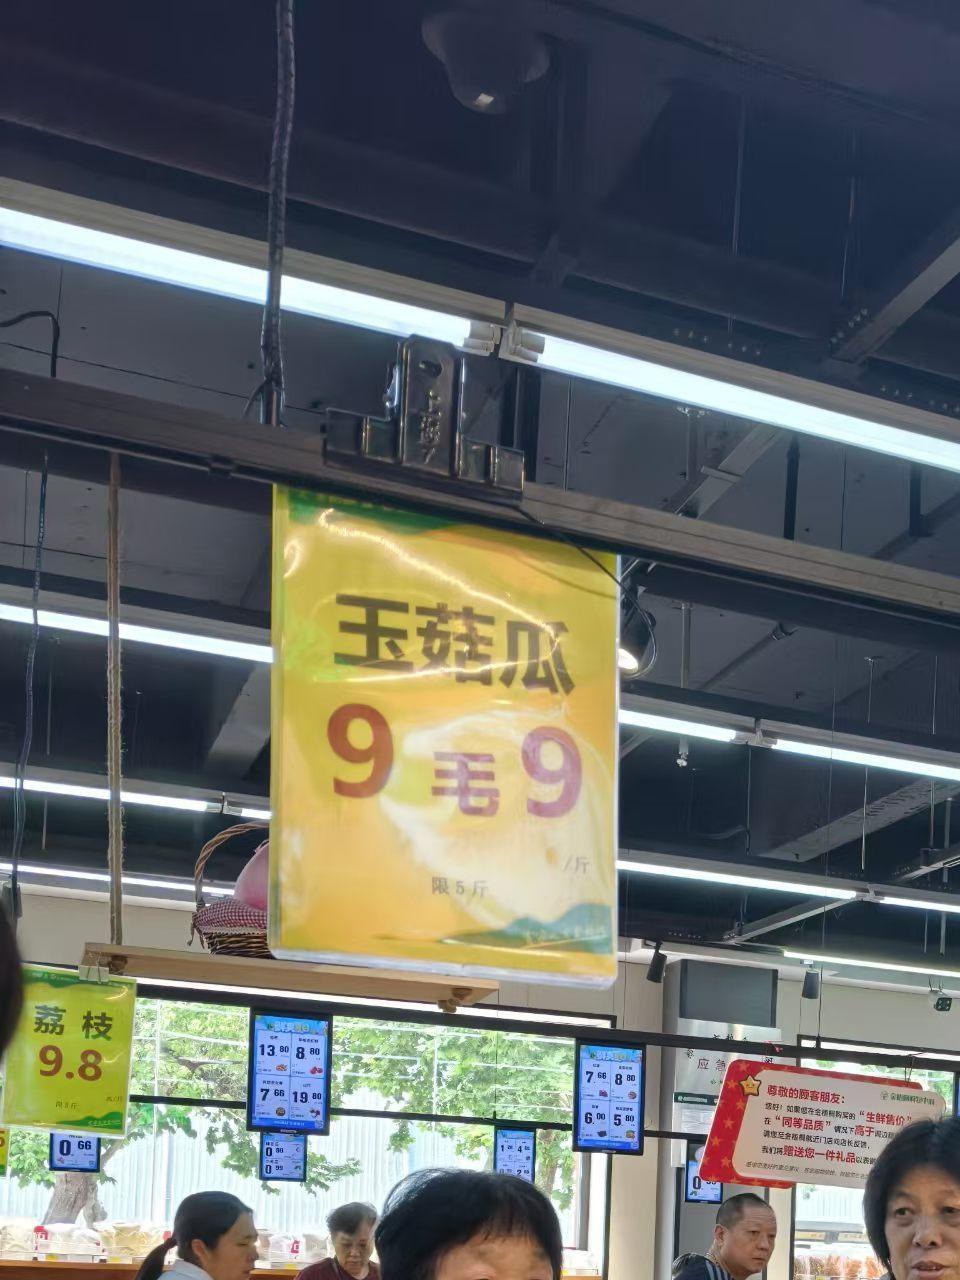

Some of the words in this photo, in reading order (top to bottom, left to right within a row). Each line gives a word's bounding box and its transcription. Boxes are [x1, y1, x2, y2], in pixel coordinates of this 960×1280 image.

[333, 593, 575, 697] 玉菇瓜
[33, 1004, 114, 1042] 荔枝
[39, 1044, 103, 1082] 9.8
[767, 1084, 846, 1105] 尊敬的顾客朋友：
